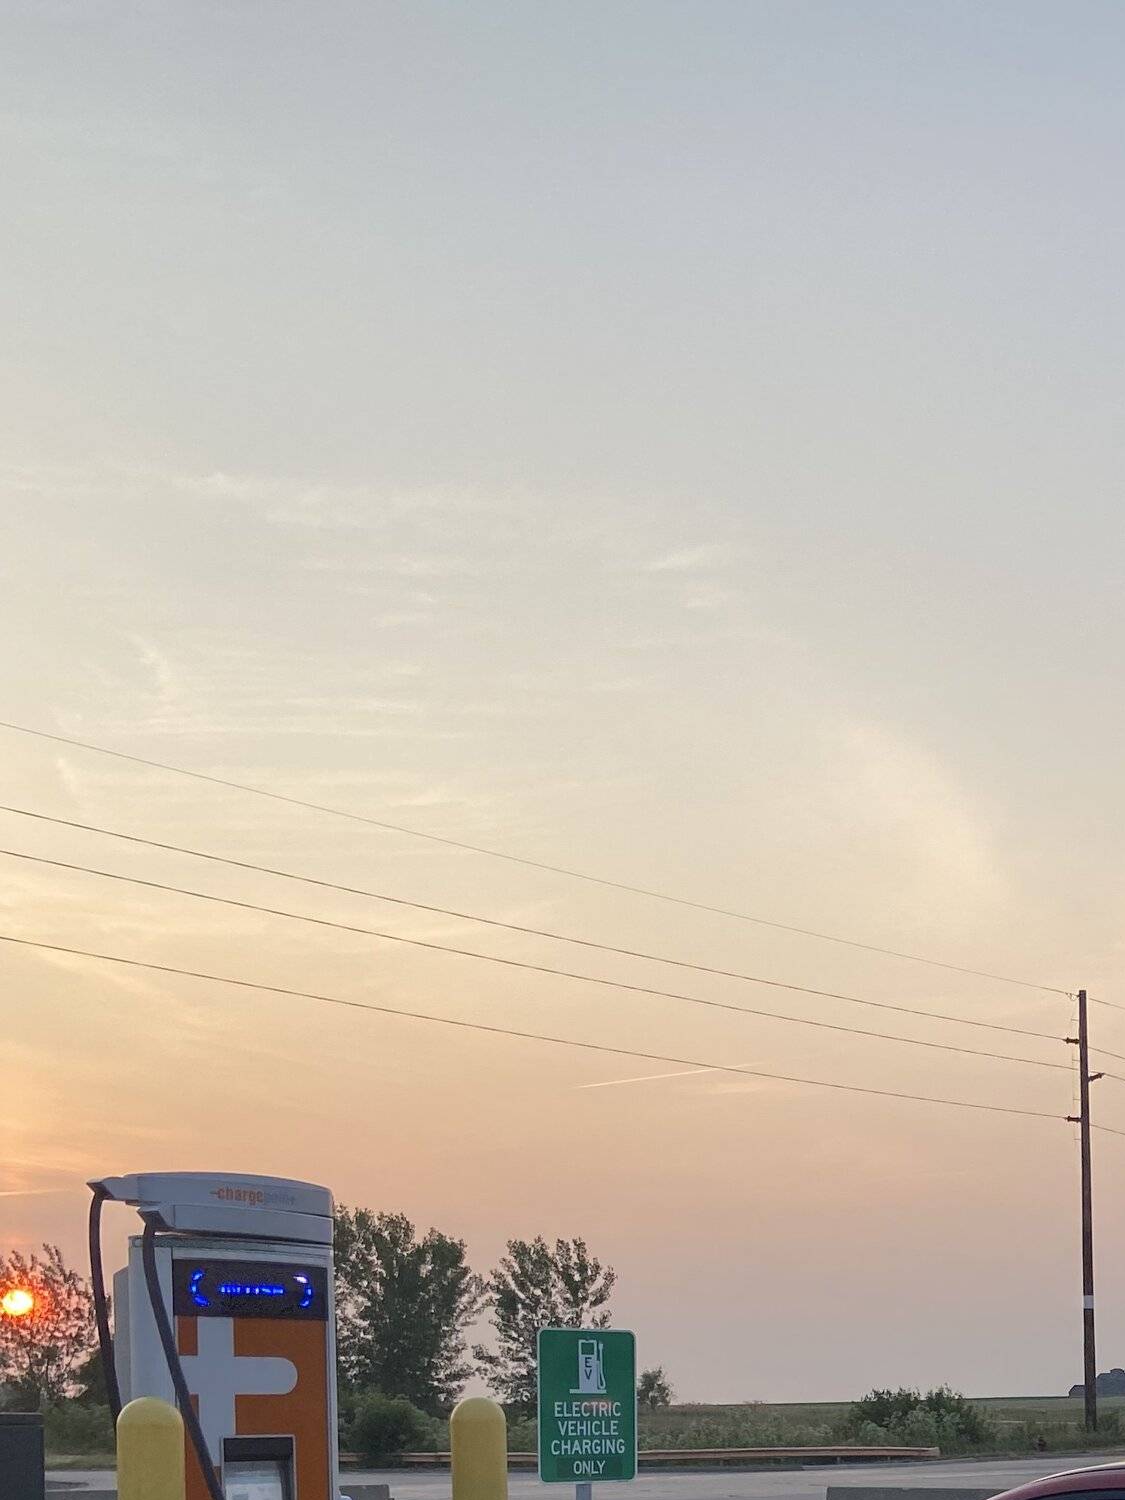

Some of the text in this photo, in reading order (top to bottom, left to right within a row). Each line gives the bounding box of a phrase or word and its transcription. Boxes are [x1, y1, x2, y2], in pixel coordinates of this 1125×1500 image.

[554, 1402, 622, 1418] ELECTRIC
[557, 1420, 619, 1436] VEHICLE
[551, 1438, 626, 1456] CHARGING
[573, 1460, 606, 1475] ONLY
